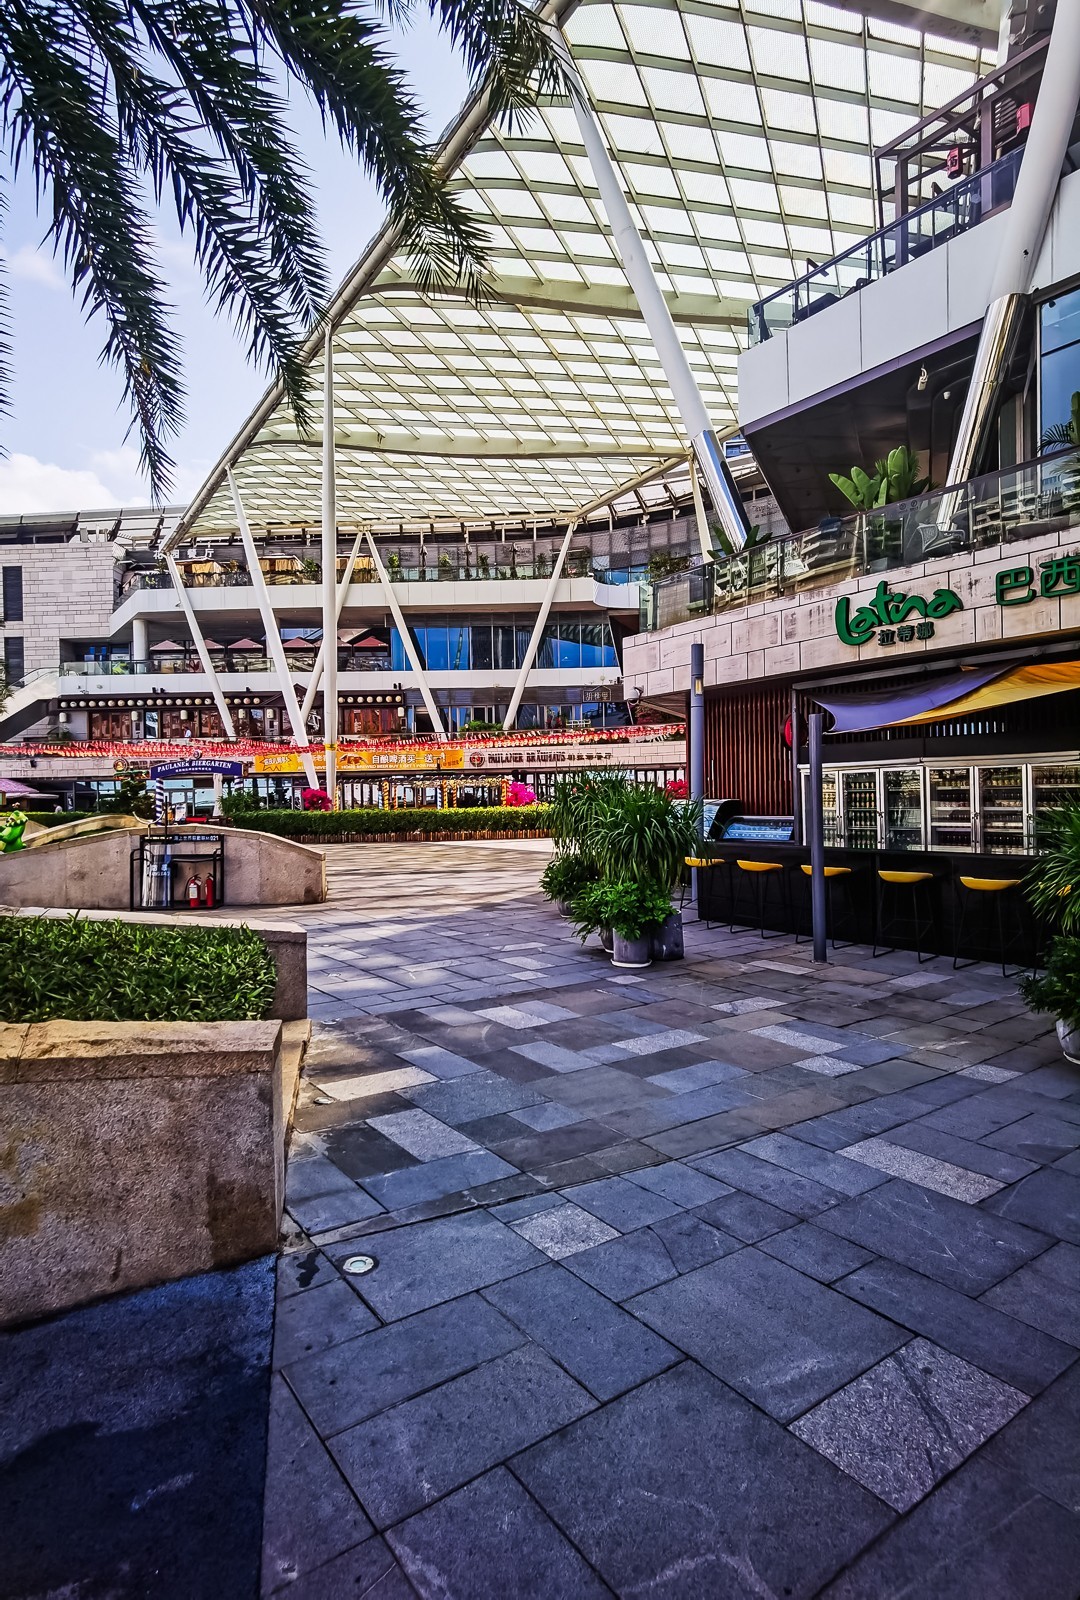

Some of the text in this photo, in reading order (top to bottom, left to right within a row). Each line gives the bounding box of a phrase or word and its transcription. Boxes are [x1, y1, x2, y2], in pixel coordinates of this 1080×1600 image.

[995, 556, 1080, 606] 巴西
[835, 580, 964, 646] Latina
[878, 621, 935, 646] 拉蒂娜
[192, 760, 232, 769] BIERGARTEN
